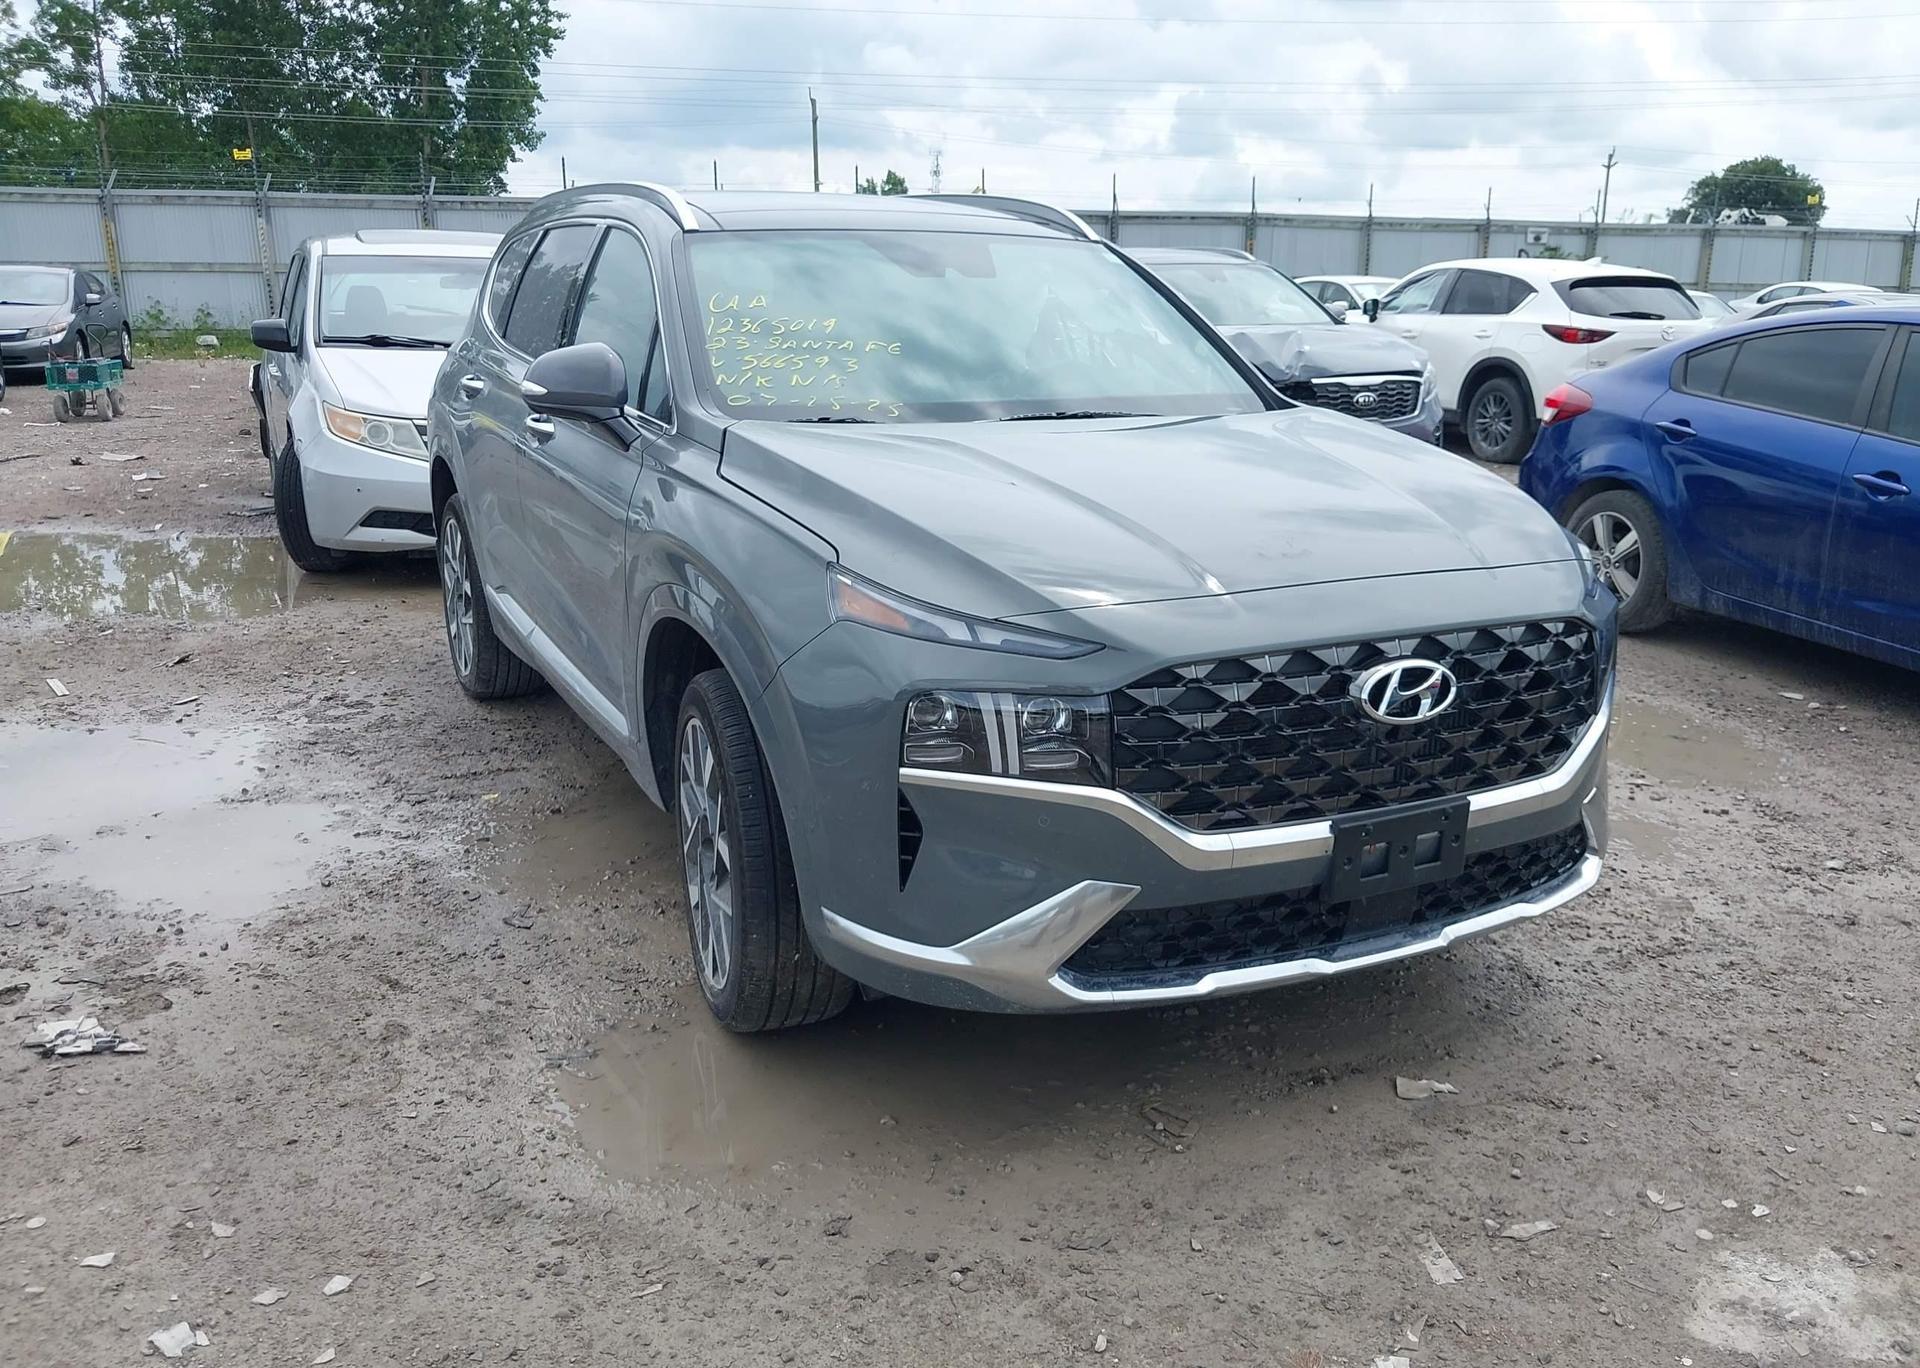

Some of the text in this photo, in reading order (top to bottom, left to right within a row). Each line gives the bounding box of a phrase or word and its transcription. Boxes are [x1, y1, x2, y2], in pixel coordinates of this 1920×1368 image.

[706, 316, 837, 334] 12365019
[765, 336, 855, 351] SANTA
[865, 340, 902, 354] FE
